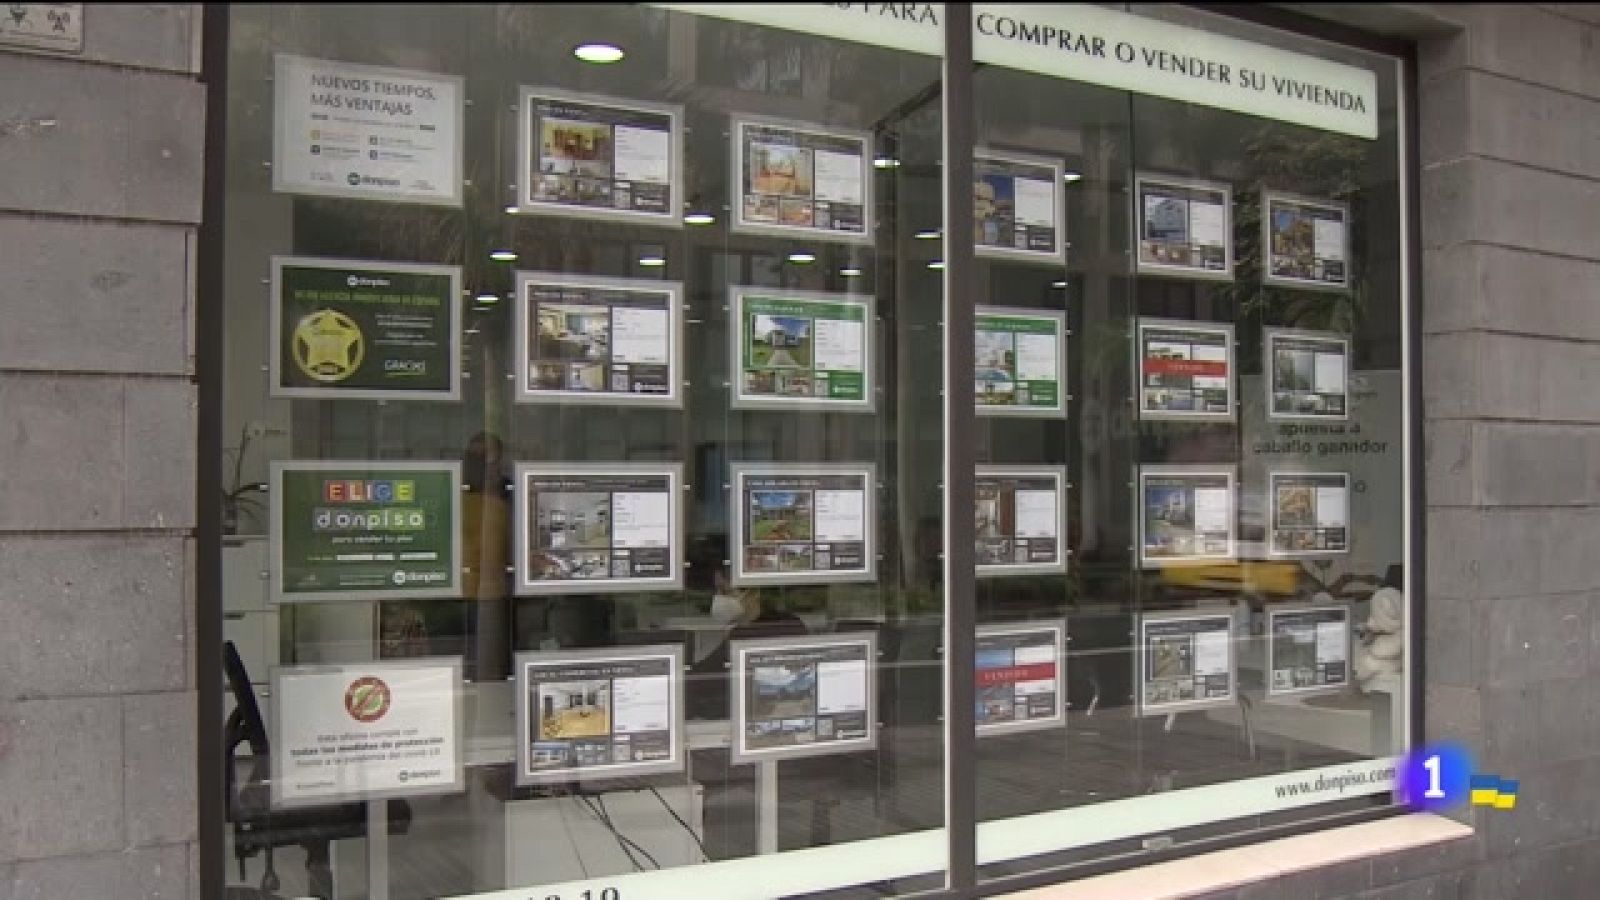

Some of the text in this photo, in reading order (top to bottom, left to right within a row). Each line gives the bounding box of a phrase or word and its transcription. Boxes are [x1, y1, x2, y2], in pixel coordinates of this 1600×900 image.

[864, 2, 1366, 114] ARA COMPRAR O VENDER SU VIVIENDA
[311, 74, 371, 93] NUEVOS
[328, 483, 412, 501] ELIGE
[316, 509, 424, 531] donpiso
[1274, 766, 1396, 798] www.donpiso.com
